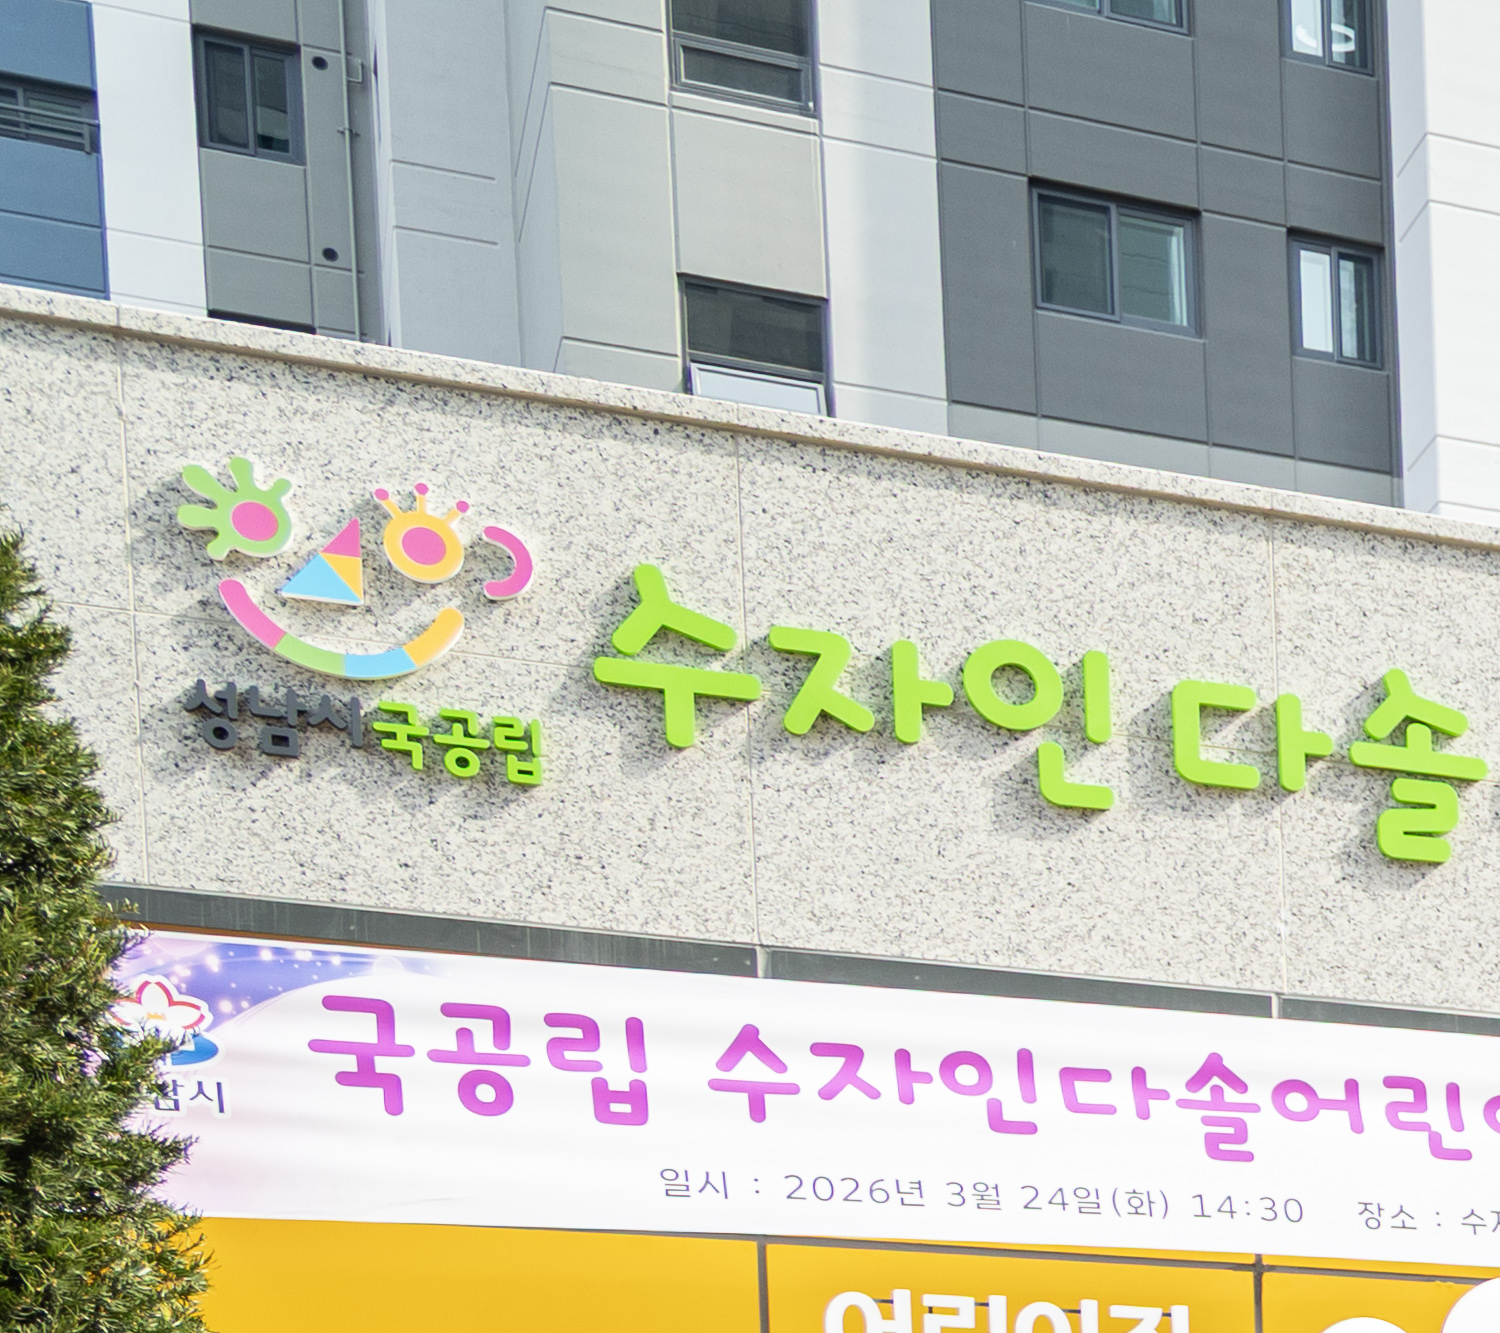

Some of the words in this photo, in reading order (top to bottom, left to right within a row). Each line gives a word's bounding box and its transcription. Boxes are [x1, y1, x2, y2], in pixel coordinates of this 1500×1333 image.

[307, 994, 649, 1127] 국공립
[659, 1167, 729, 1201] 일시
[783, 1172, 926, 1208] 2026년
[945, 1180, 1002, 1212] 3월
[1021, 1182, 1170, 1221] 24일(화)
[1191, 1192, 1304, 1224] 14:30
[1356, 1201, 1418, 1231] 장소
